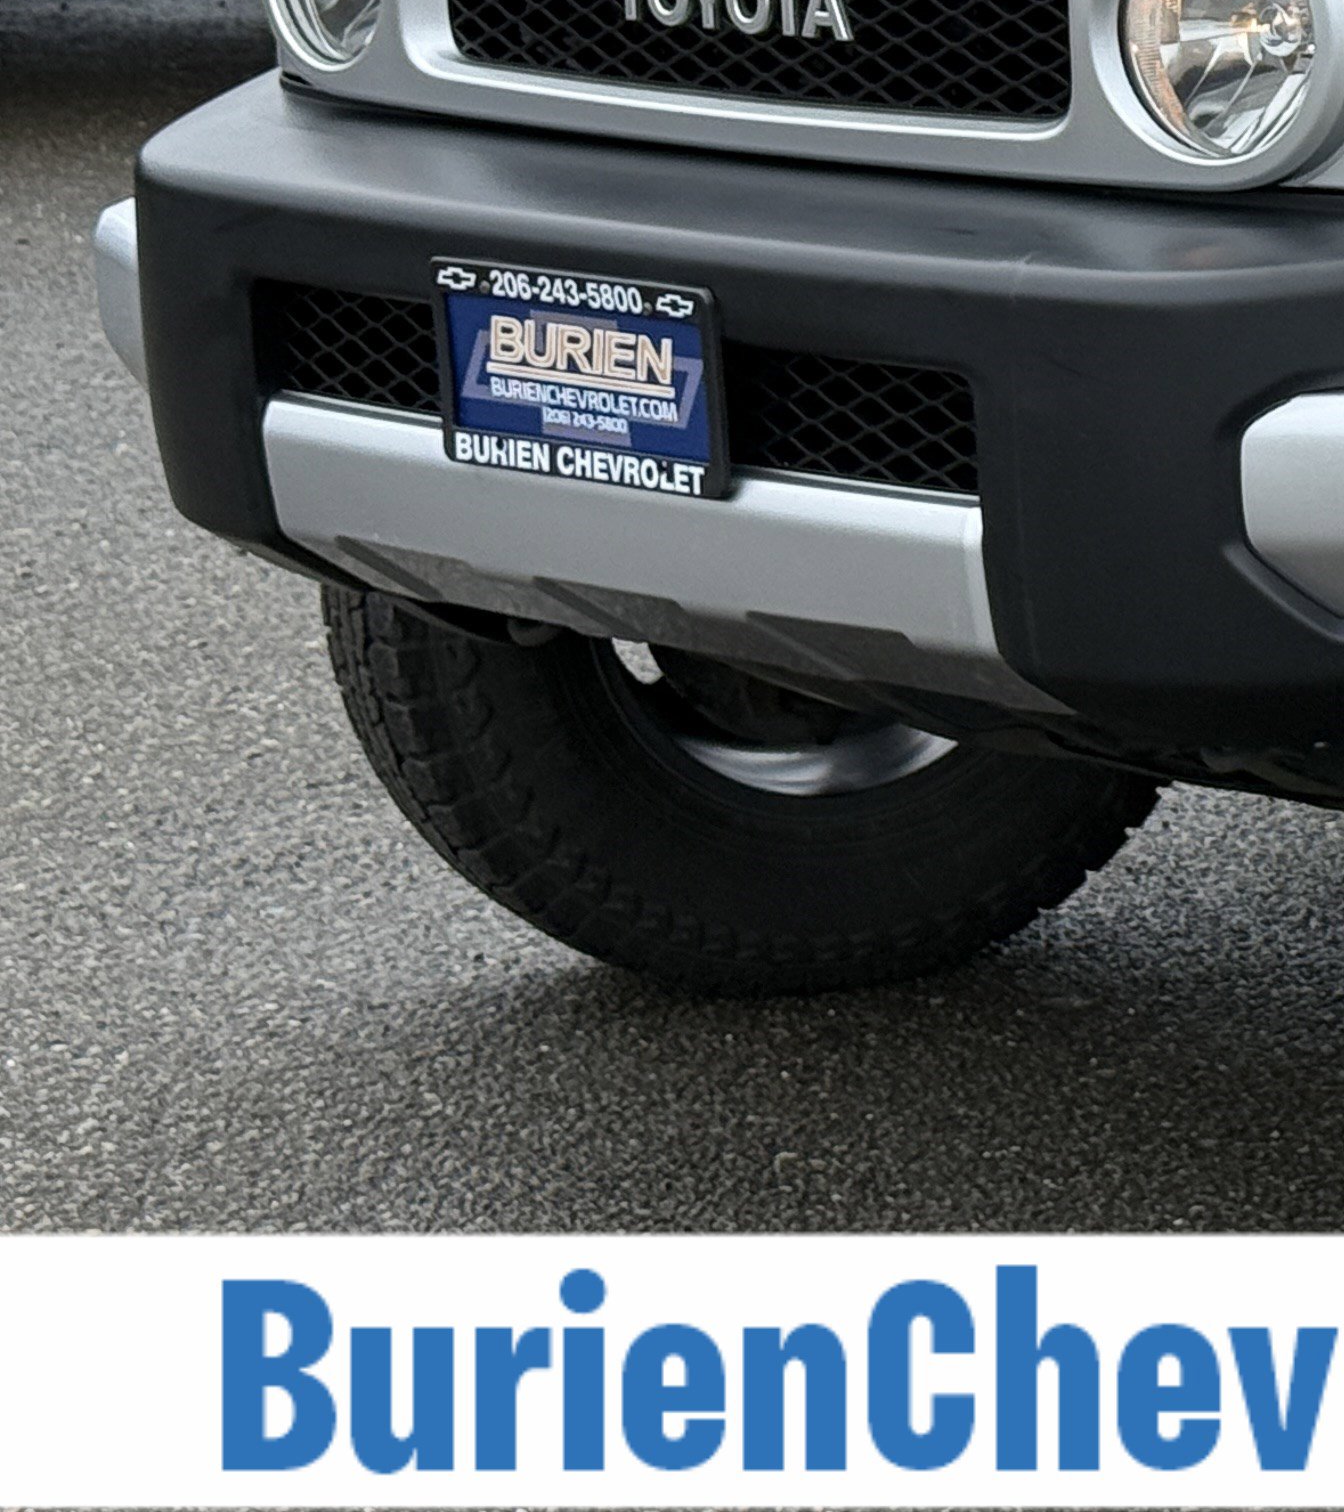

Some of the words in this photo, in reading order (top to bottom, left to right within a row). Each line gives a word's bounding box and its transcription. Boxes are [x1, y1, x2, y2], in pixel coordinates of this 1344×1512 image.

[488, 269, 643, 314] 206-243-5800
[488, 314, 674, 386] BURIEN
[490, 376, 678, 422] BURIENCHEVROLET.COM
